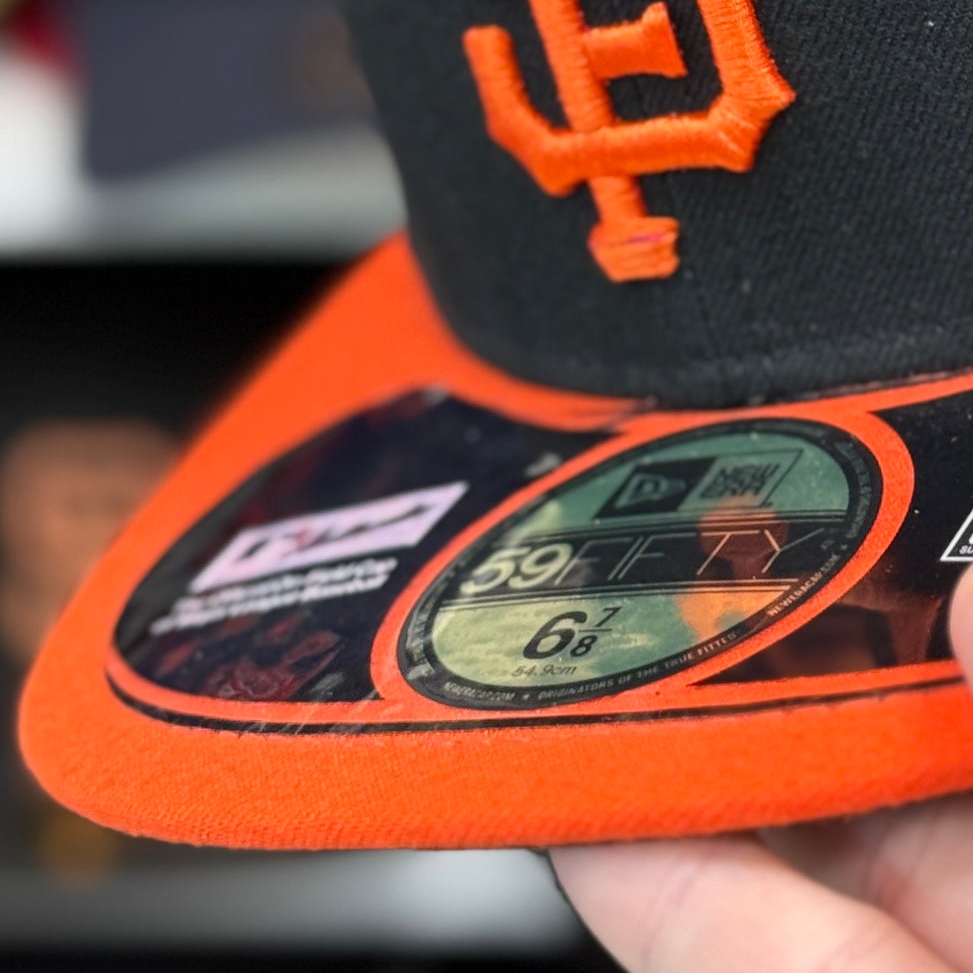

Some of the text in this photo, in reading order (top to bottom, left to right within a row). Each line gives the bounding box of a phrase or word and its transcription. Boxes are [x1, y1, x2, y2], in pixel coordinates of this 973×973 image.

[711, 463, 781, 482] NEW
[460, 528, 825, 594] 59FIFTY
[537, 677, 614, 701] ORIGINATORS
[618, 675, 633, 685] OF
[664, 652, 695, 669] TRUE
